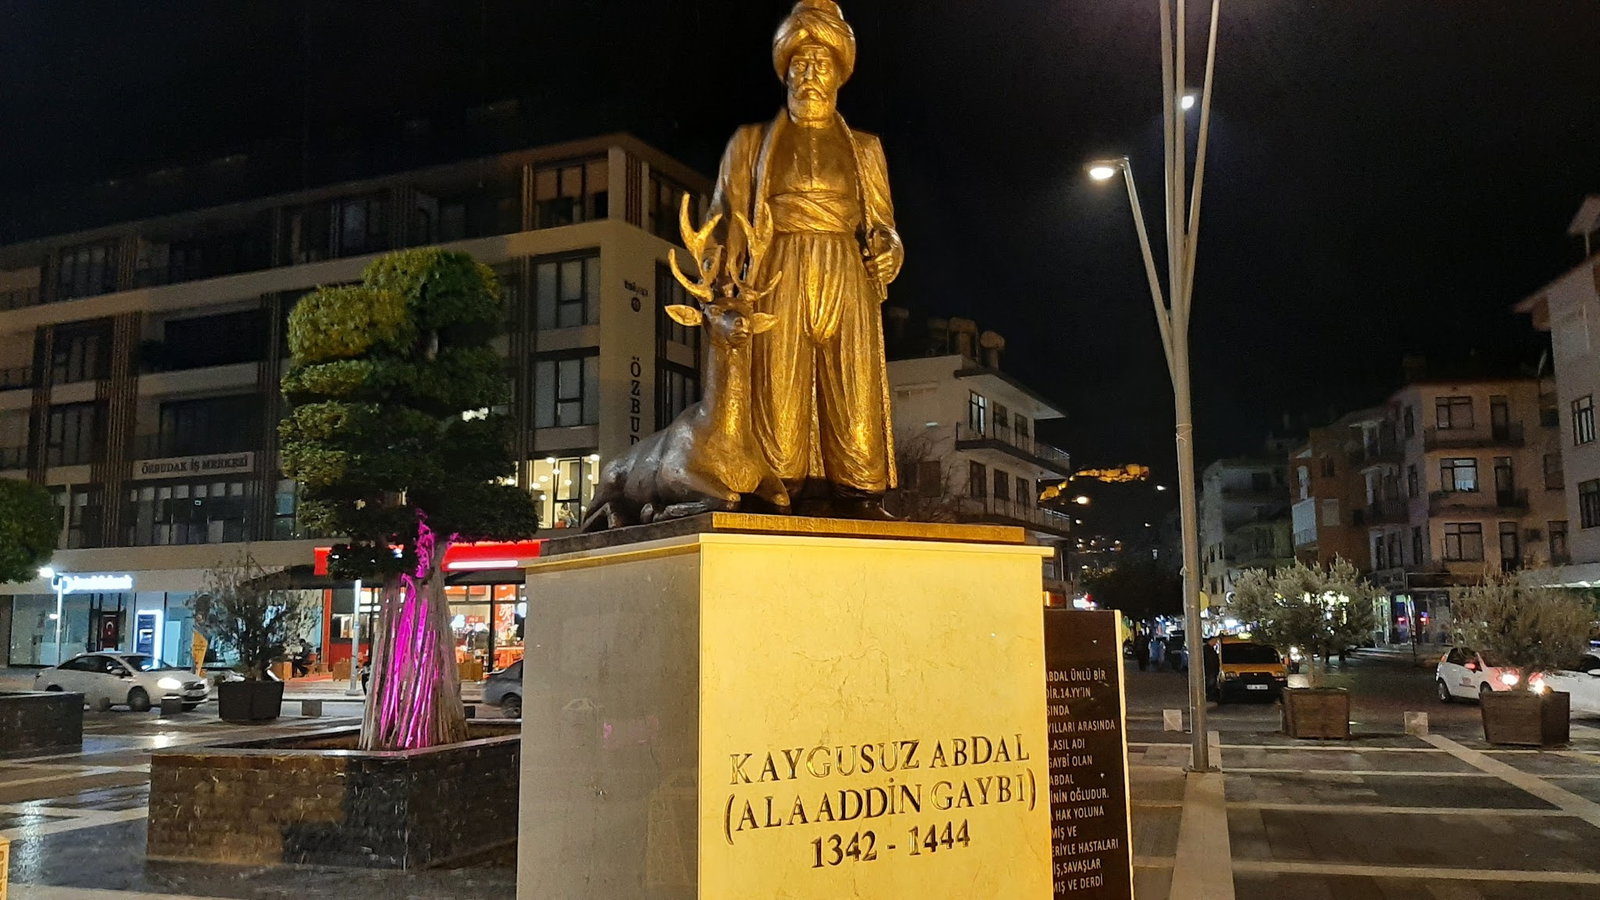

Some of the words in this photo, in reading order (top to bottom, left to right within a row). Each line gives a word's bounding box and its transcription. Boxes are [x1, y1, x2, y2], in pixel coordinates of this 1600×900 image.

[1070, 668, 1091, 681] ÜNLÜ
[1093, 667, 1106, 681] BİR
[1048, 721, 1075, 734] YILLARI
[1077, 719, 1116, 732] ARASINDA
[1071, 738, 1085, 749] ADI
[729, 739, 920, 785] KAYGUSUZ
[929, 733, 1030, 768] ABDAL
[1071, 754, 1093, 767] OLAN
[1050, 773, 1075, 786] ABDAL
[1069, 786, 1110, 802] OĞLUDUR.
[723, 777, 922, 846] (ALAADDİN
[930, 767, 1037, 812] GAYBI)
[1055, 808, 1072, 821] HAK
[1073, 805, 1104, 819] YOLUNA
[1066, 825, 1077, 838] VE
[811, 830, 878, 868] 1342
[908, 819, 971, 857] 1444
[1078, 838, 1119, 854] HASTALARI
[1067, 878, 1078, 891] VE
[1080, 873, 1103, 890] DERDİ
